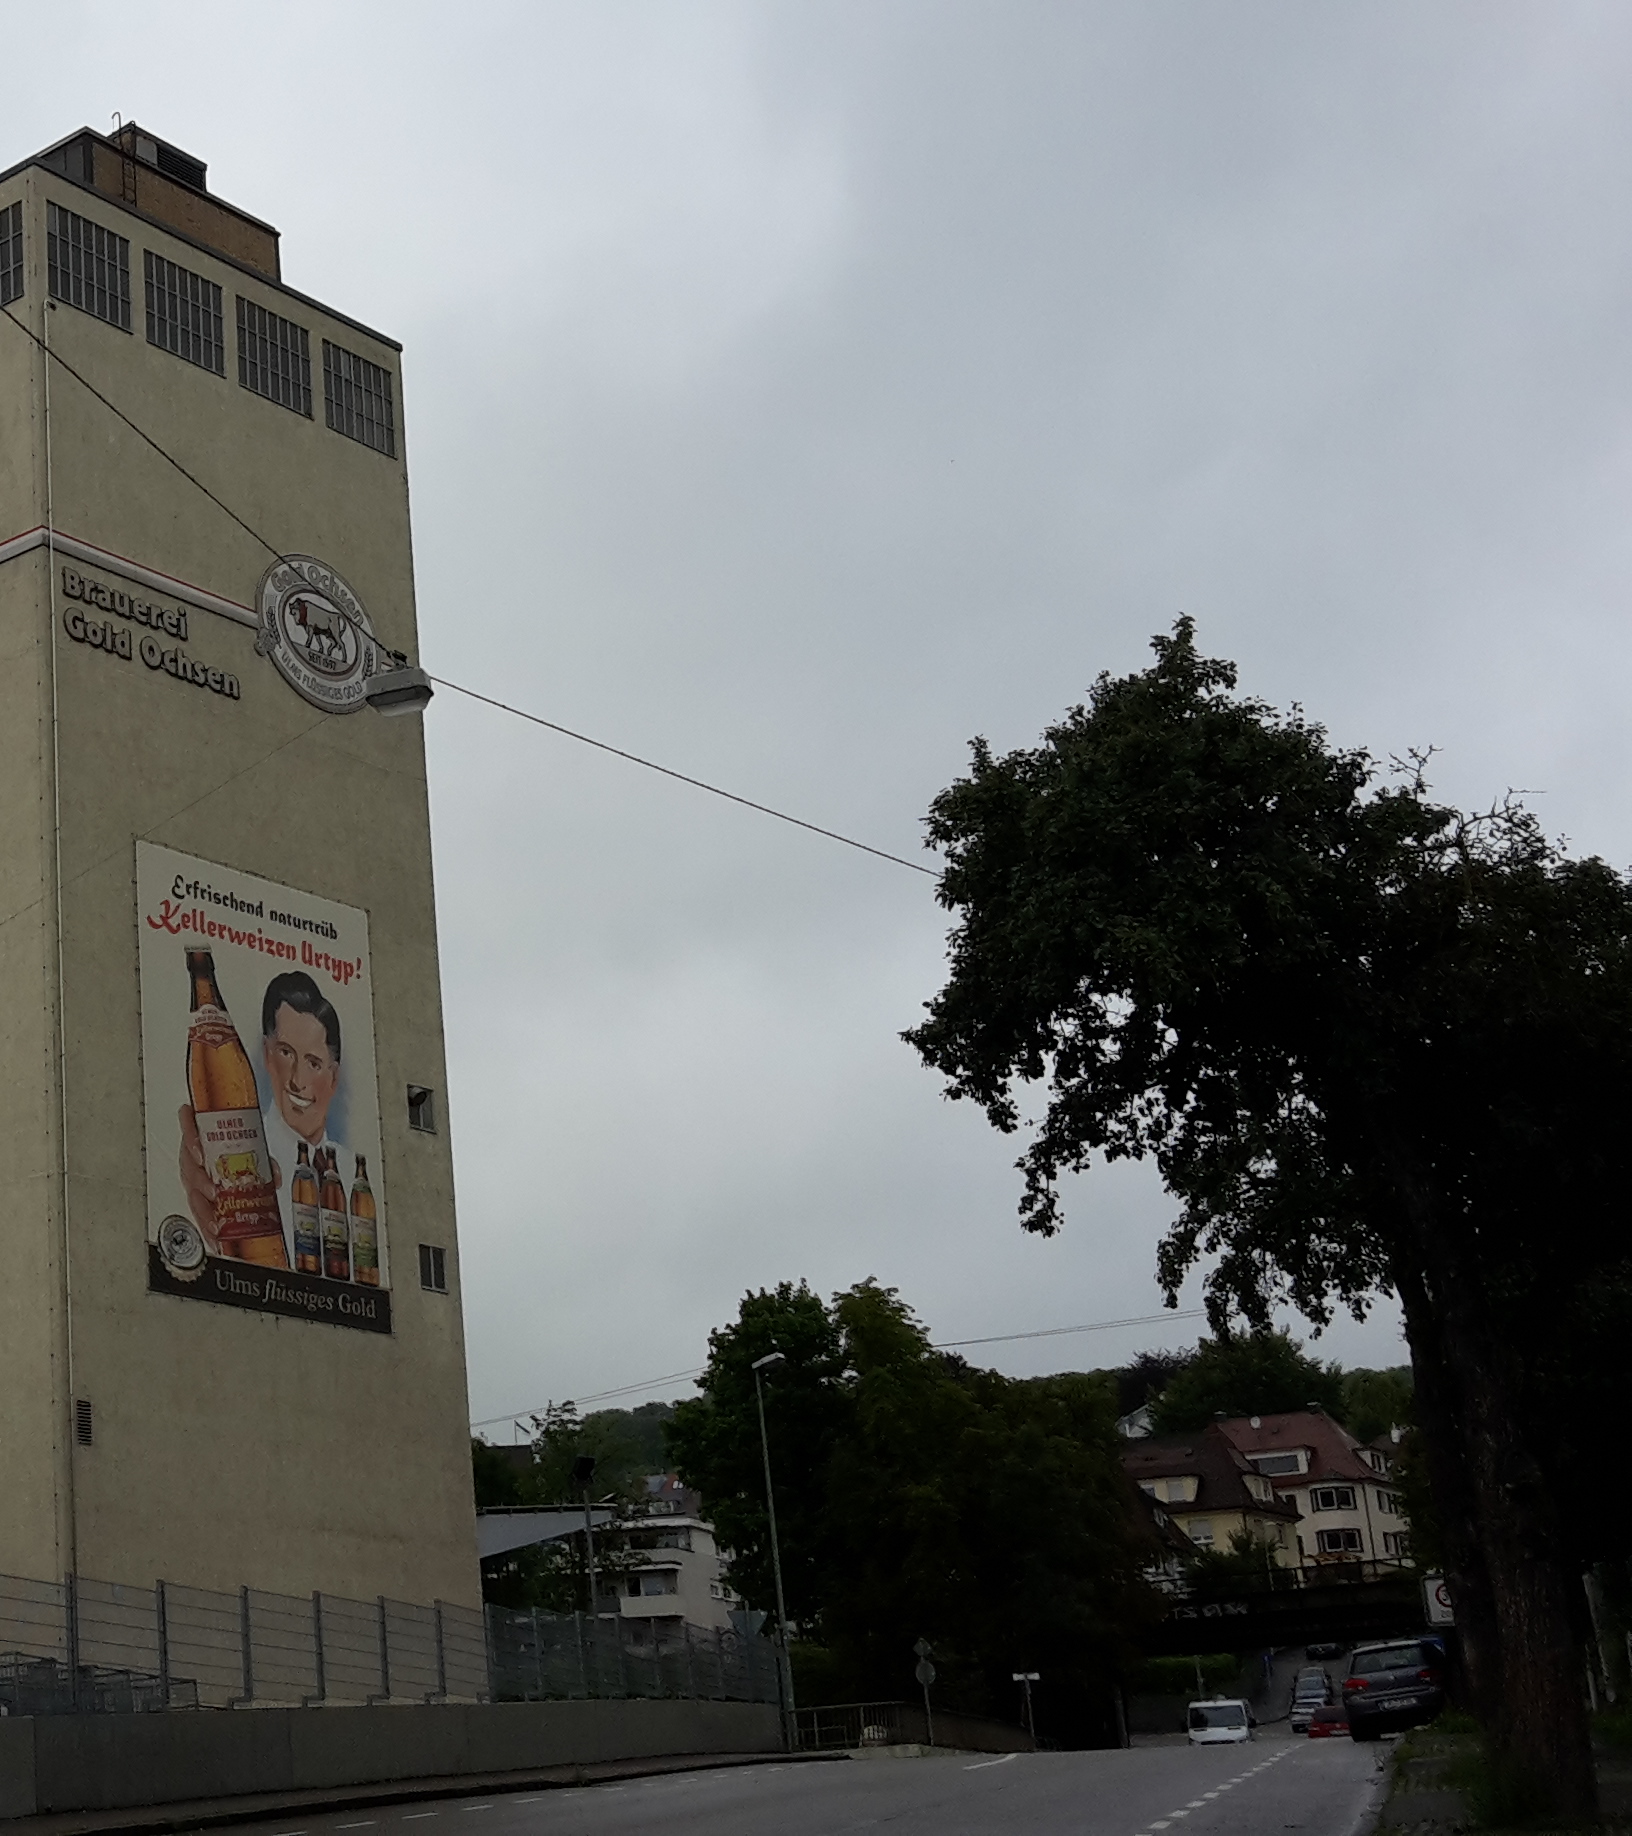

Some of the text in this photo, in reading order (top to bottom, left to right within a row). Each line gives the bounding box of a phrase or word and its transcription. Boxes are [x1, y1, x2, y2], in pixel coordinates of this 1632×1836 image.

[61, 566, 188, 641] Brauerei
[307, 566, 364, 626] Ochsen
[63, 607, 241, 700] Gold Ochsen
[171, 874, 338, 940] Erfrischend naturtrüb
[146, 899, 363, 986] Kellerweizen Urtyp!
[214, 1269, 377, 1319] Ulms flüssiges Gold
